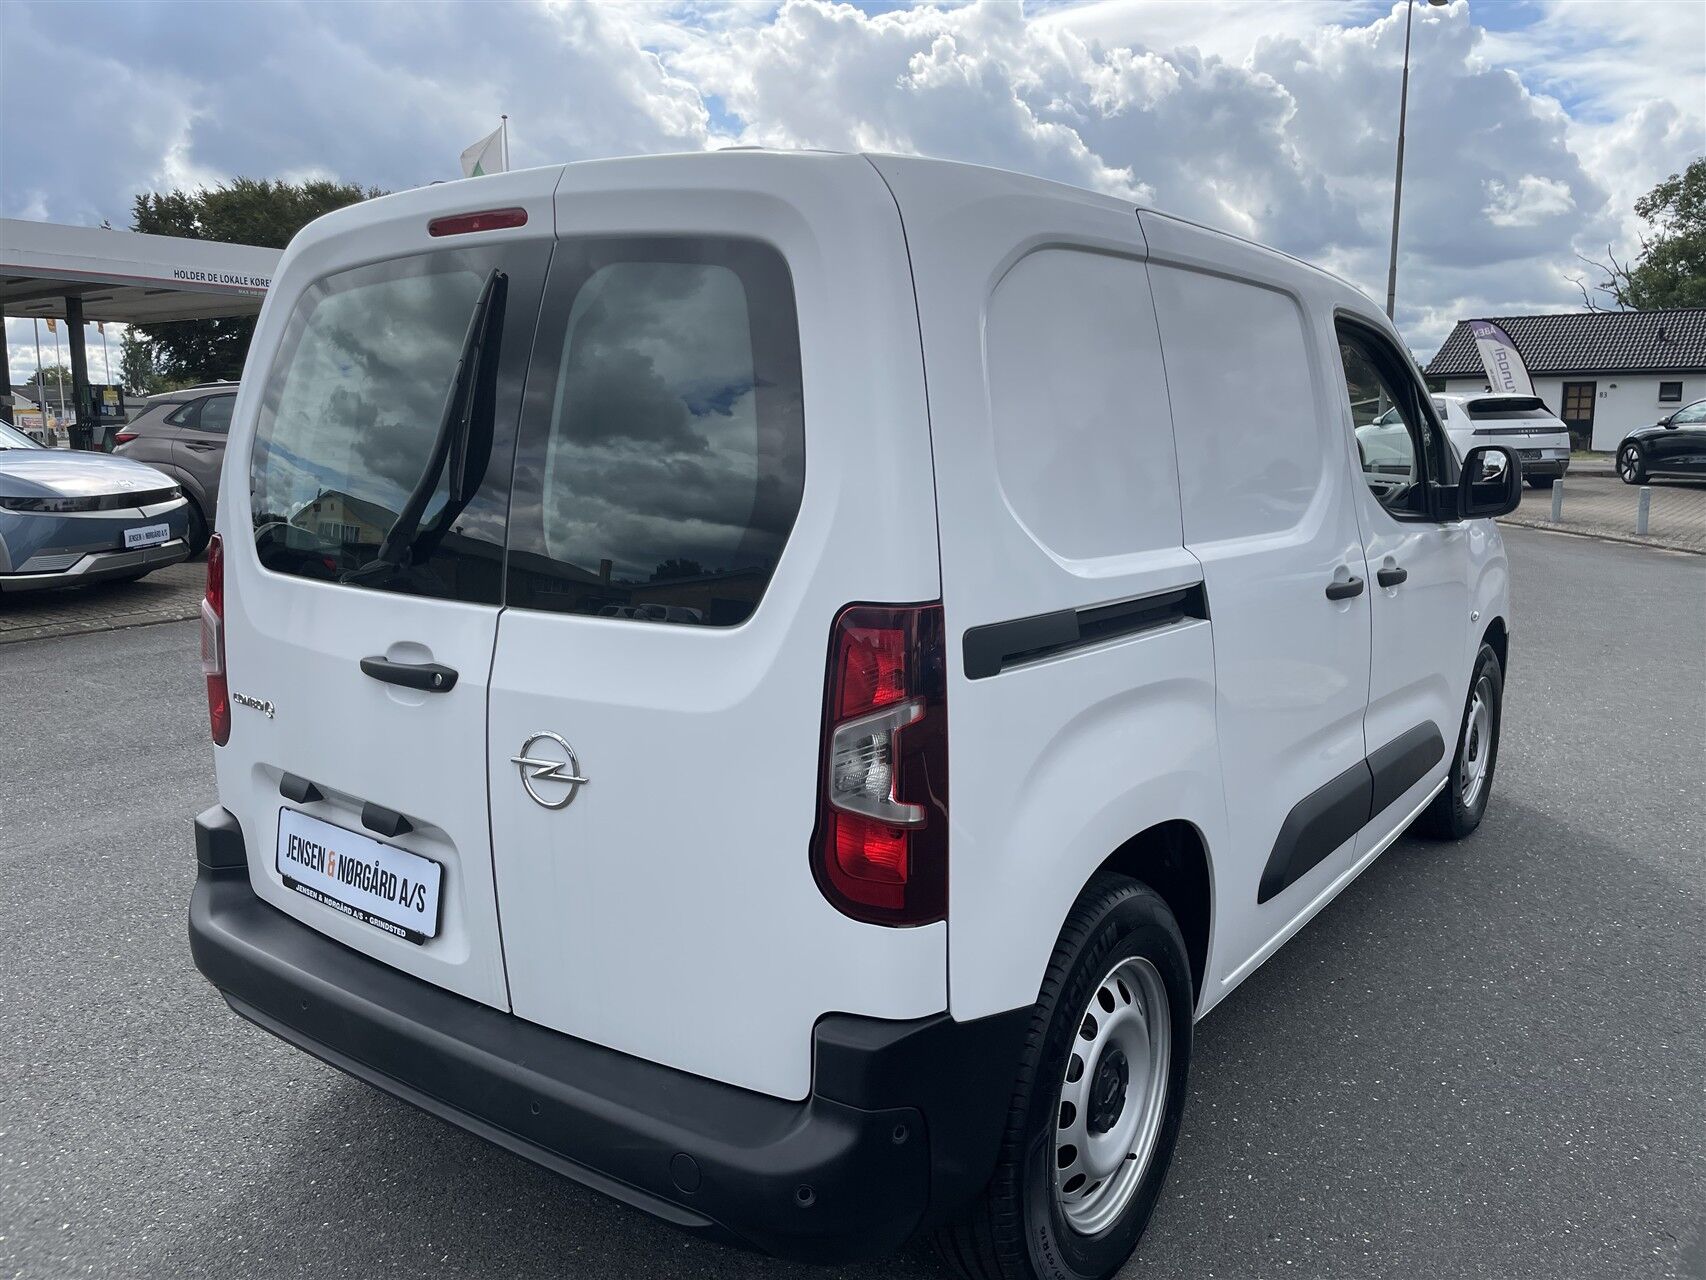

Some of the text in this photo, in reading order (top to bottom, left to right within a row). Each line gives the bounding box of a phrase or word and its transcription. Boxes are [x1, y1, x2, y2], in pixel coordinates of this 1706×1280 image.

[174, 270, 272, 288] HOLDER DE LOKALE KØRE
[1599, 391, 1608, 399] 83
[286, 833, 427, 913] JENSEN & NØRGÅRD A/S
[295, 884, 318, 899] JENSEN
[352, 910, 364, 920] A/S
[369, 916, 406, 938] GRINDSTED
